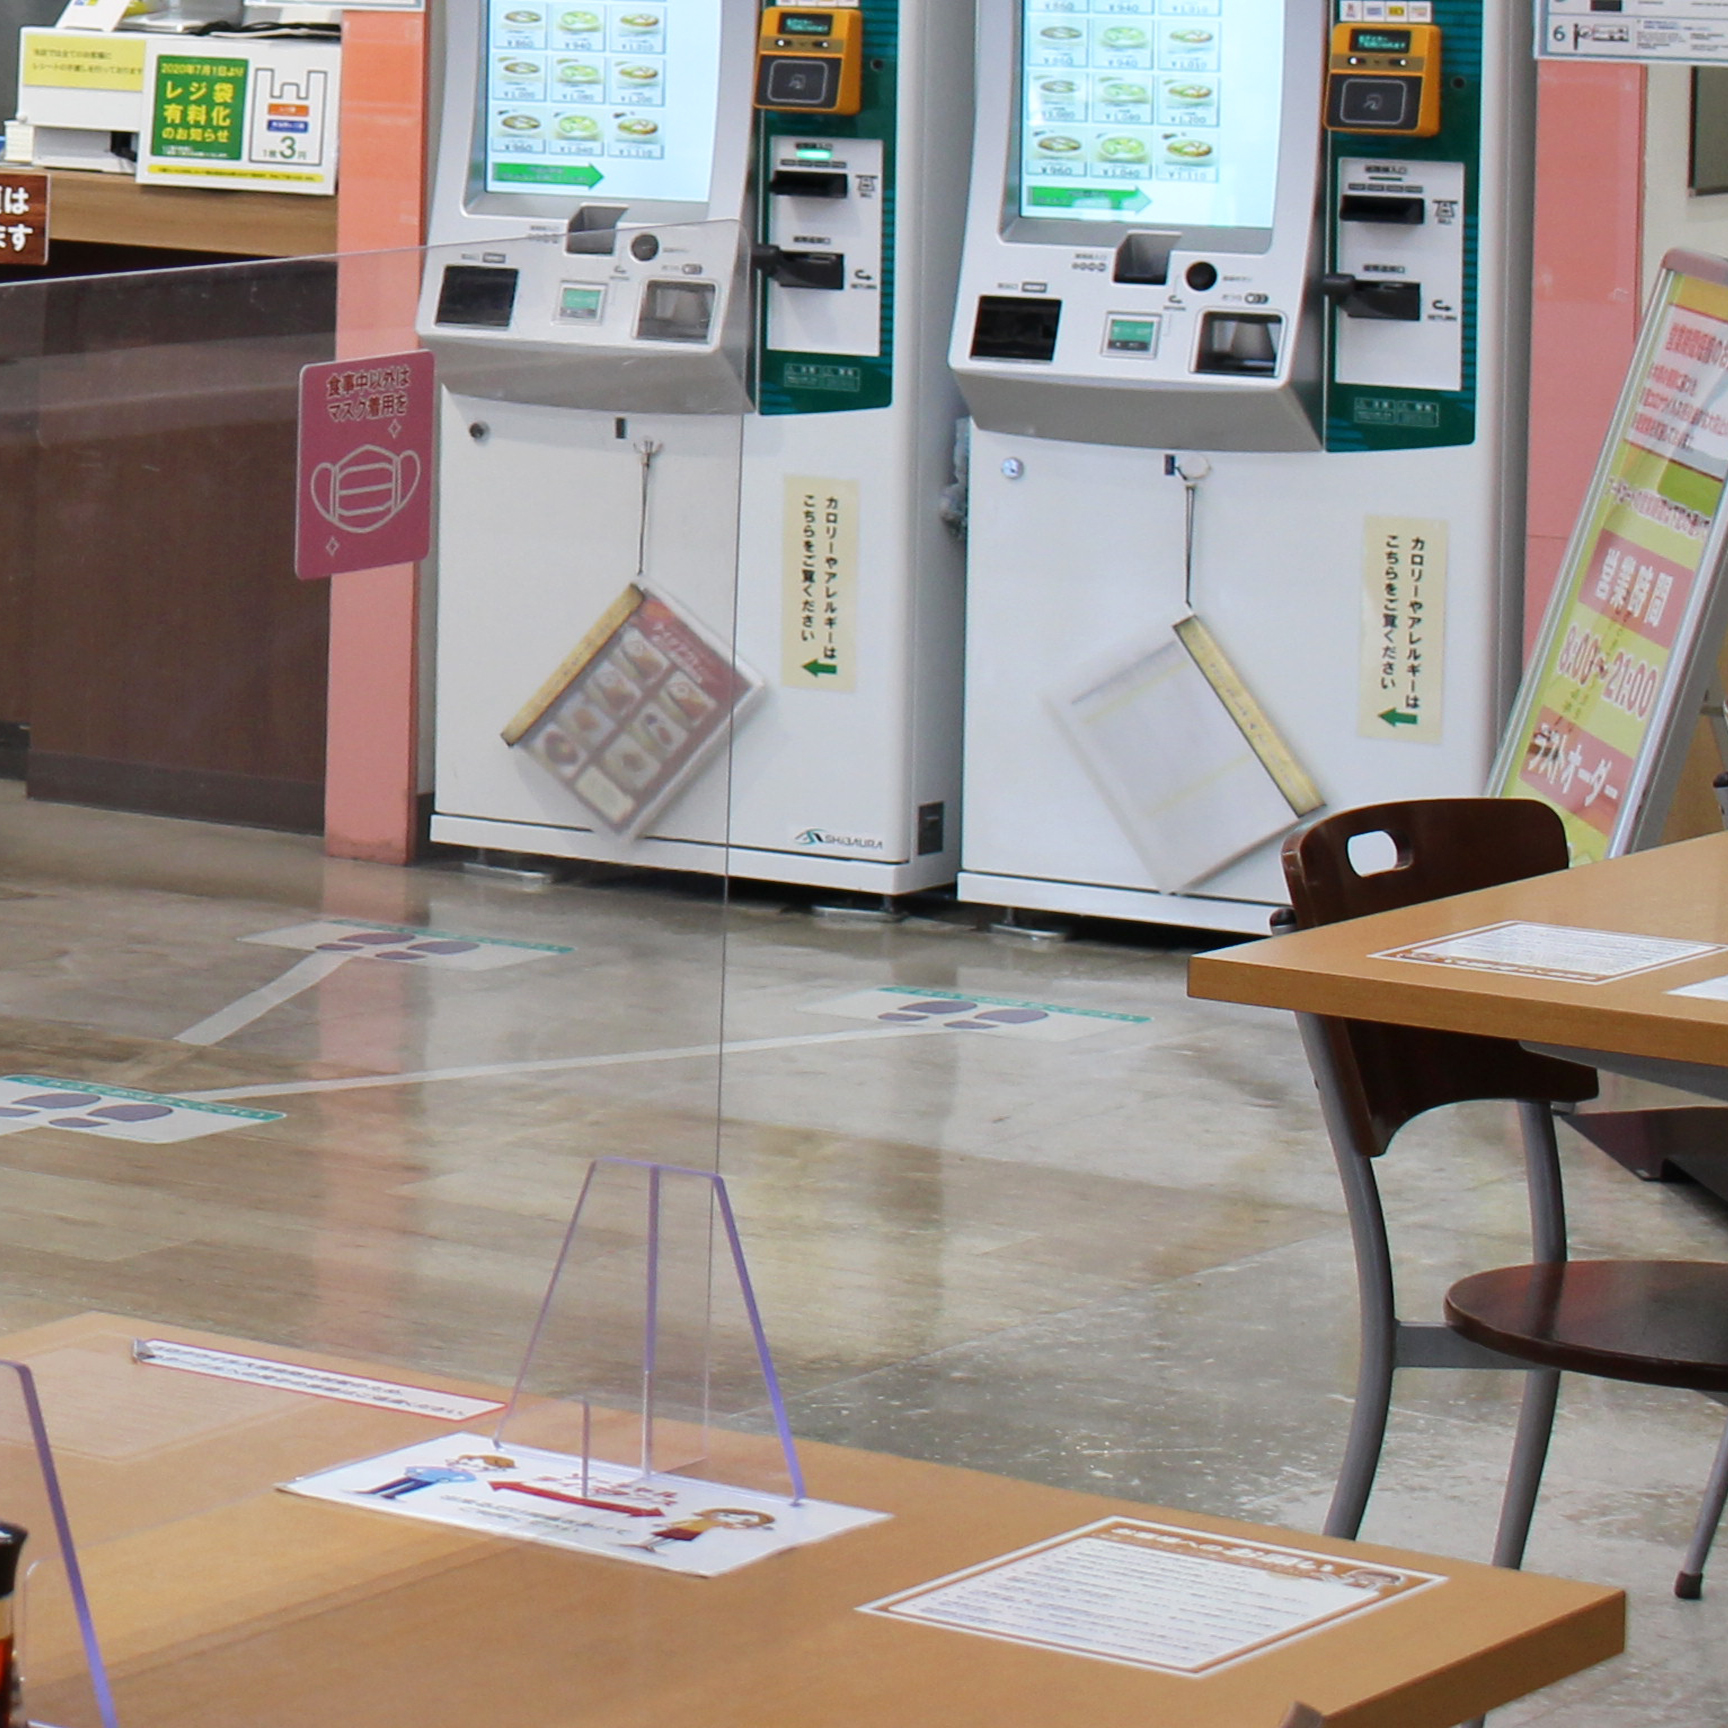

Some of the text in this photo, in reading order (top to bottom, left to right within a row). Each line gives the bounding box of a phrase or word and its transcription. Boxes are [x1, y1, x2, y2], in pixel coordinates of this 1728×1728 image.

[1552, 24, 1566, 41] 6
[165, 80, 235, 104] レジ袋
[163, 103, 232, 127] 有料化
[161, 127, 230, 143] のお知らせ
[326, 366, 411, 399] 食事中以外は
[328, 391, 410, 421] マスク着用を
[800, 494, 816, 643] こちらをご覧ください
[823, 495, 839, 660] カロリーやアレルギーは
[1593, 545, 1675, 628] 営業時間
[1380, 534, 1400, 690] こちらをご覧ください
[1405, 536, 1426, 710] カロリーやアレルギーは
